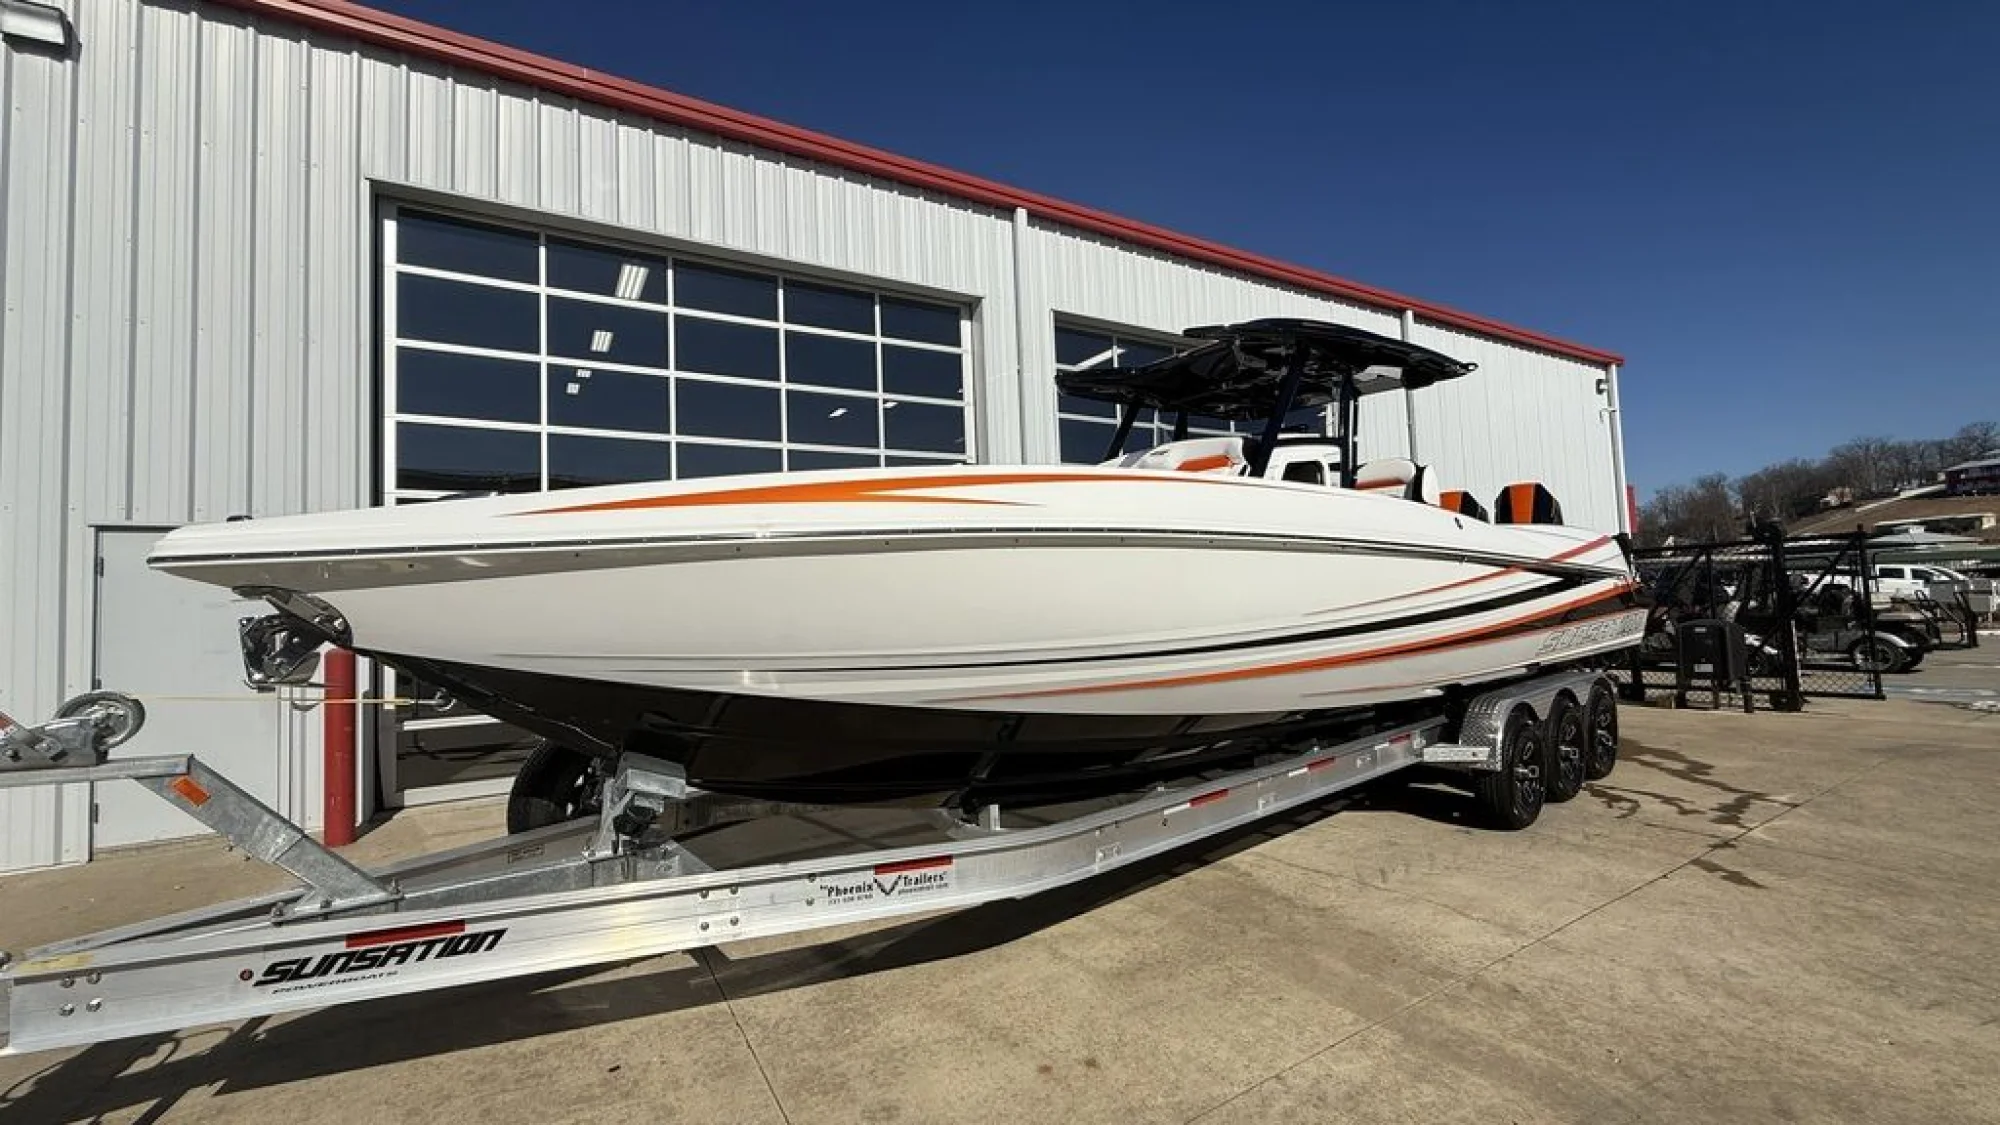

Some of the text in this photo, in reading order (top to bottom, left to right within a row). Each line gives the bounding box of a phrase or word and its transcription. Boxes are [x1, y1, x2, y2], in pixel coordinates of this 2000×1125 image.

[827, 880, 874, 897] Phoenix
[903, 871, 945, 887] Trailers
[253, 928, 508, 987] SUNSATION
